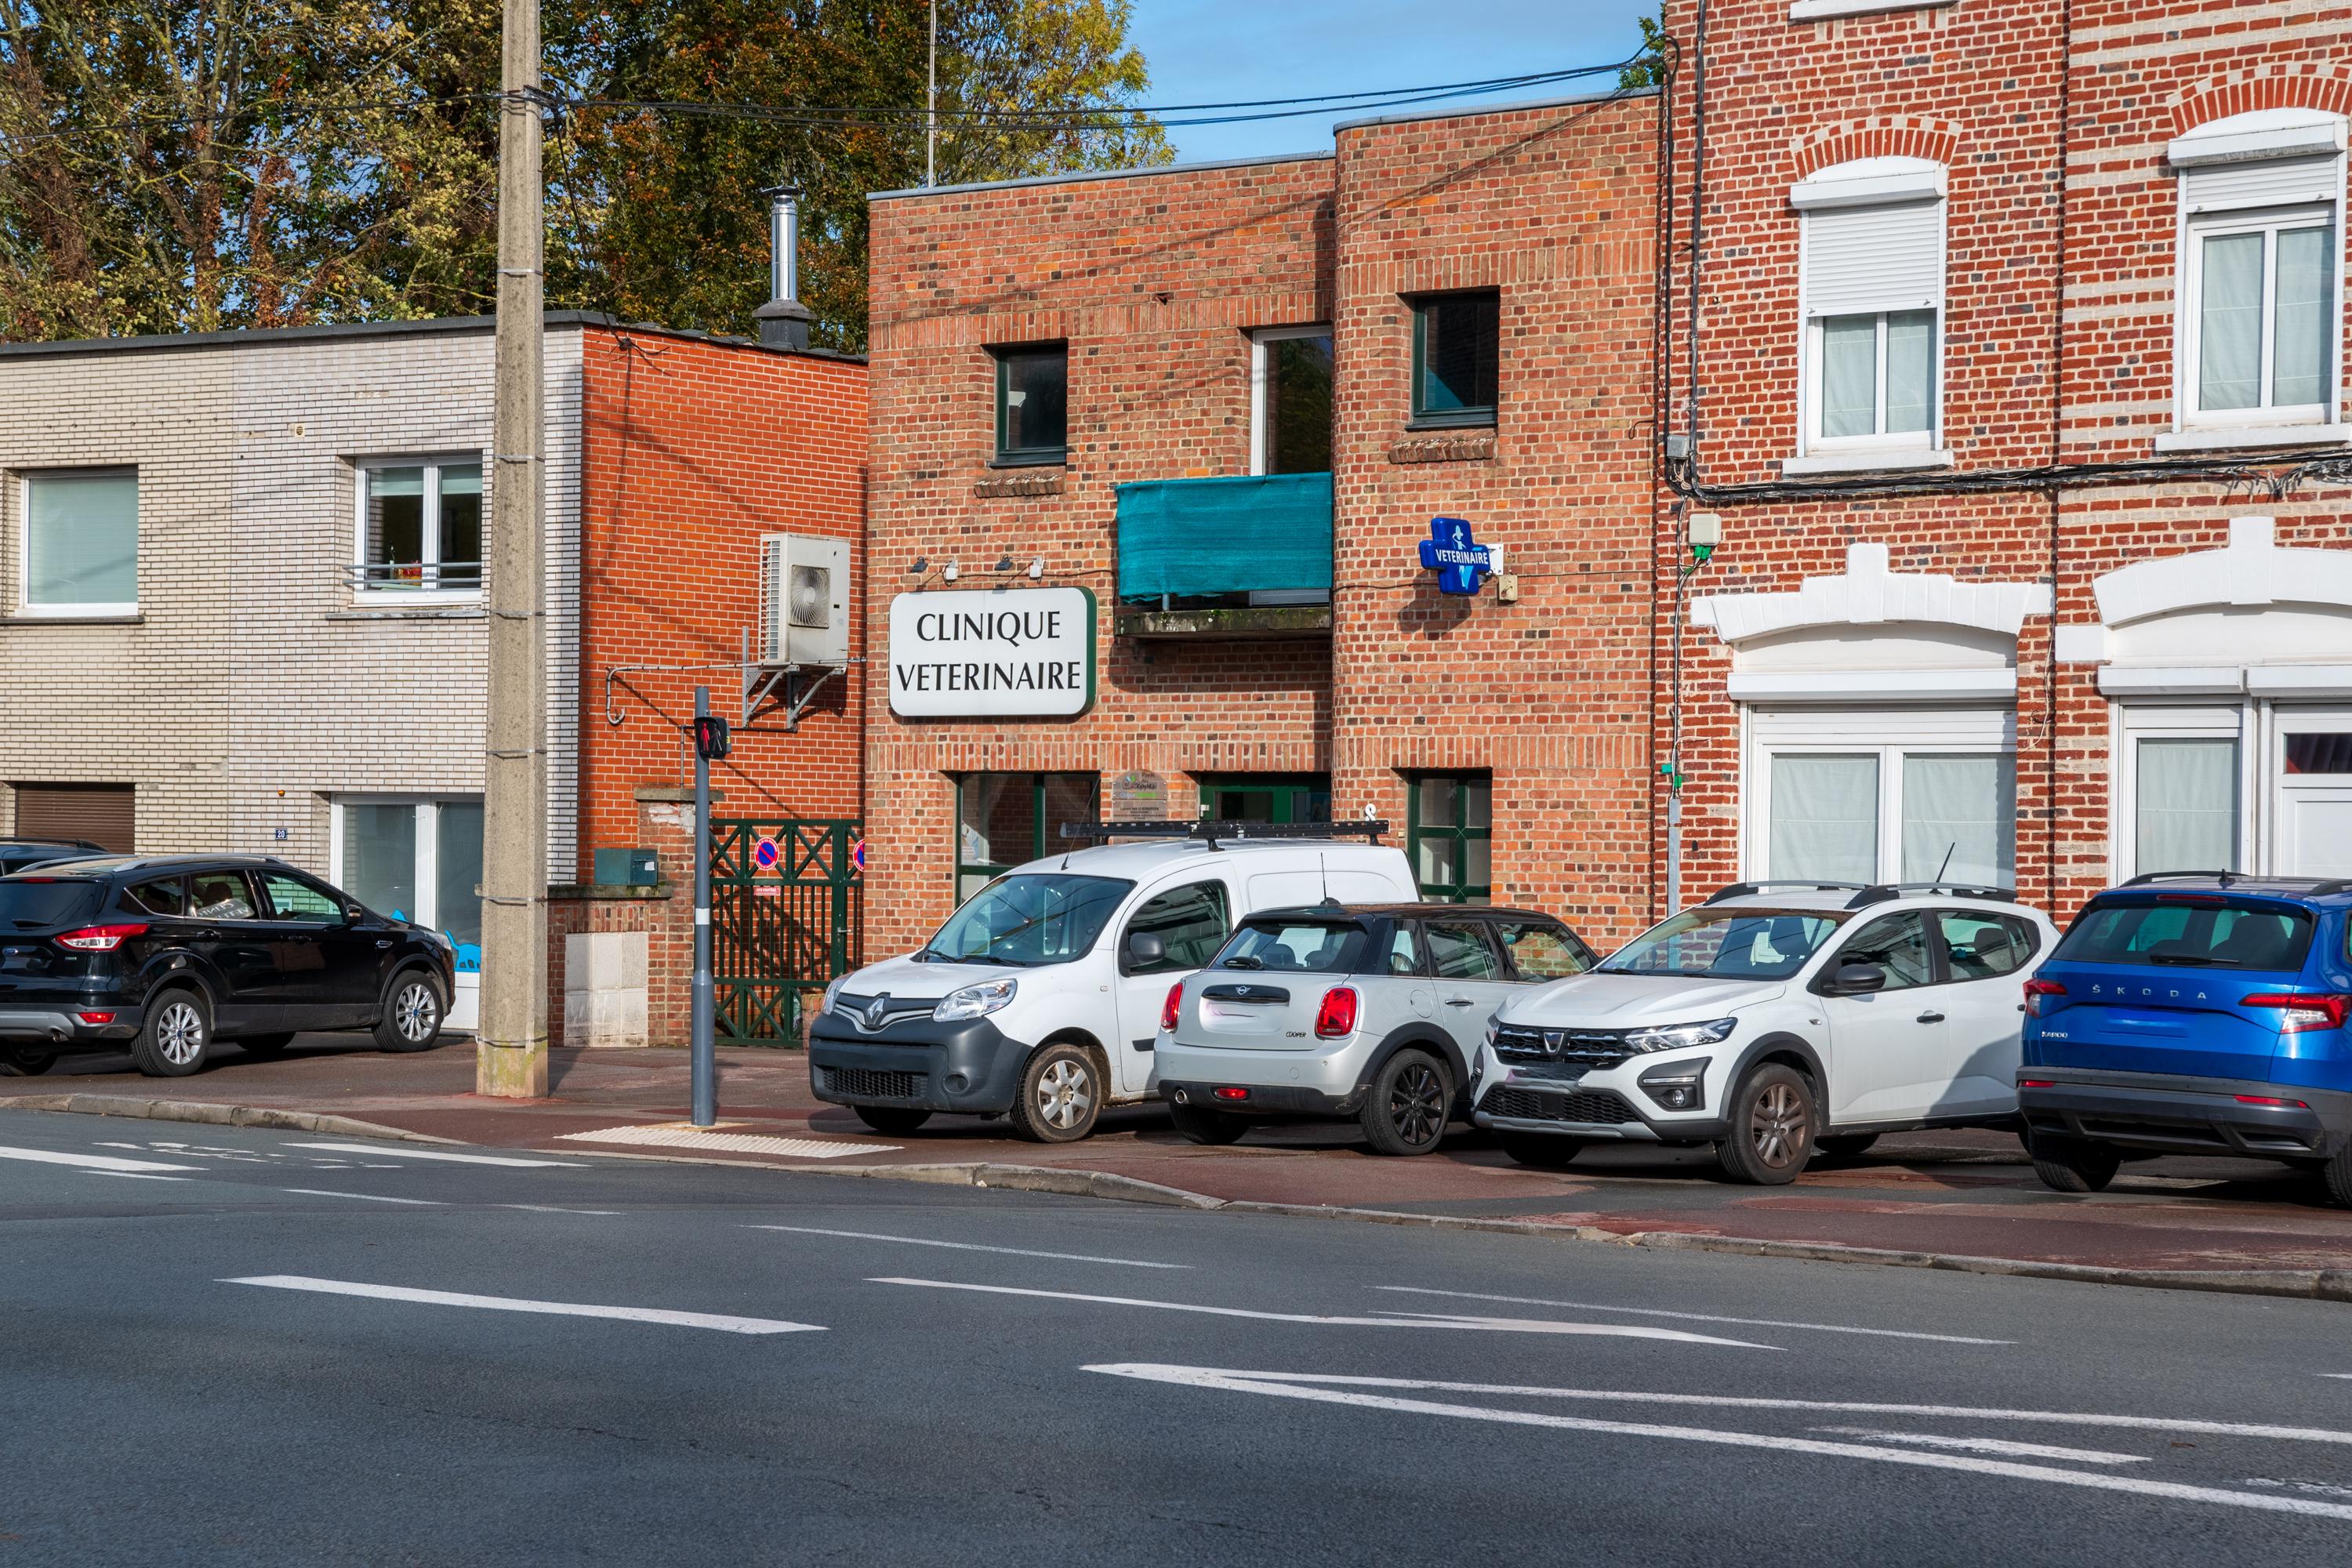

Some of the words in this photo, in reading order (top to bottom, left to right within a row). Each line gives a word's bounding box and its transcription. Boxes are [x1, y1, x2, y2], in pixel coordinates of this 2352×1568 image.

[1436, 549, 1489, 564] VETERINAIRE
[916, 611, 1060, 648] CLINIQUE
[896, 661, 1080, 691] VETERINAIRE
[2092, 984, 2207, 1000] ŠKODA
